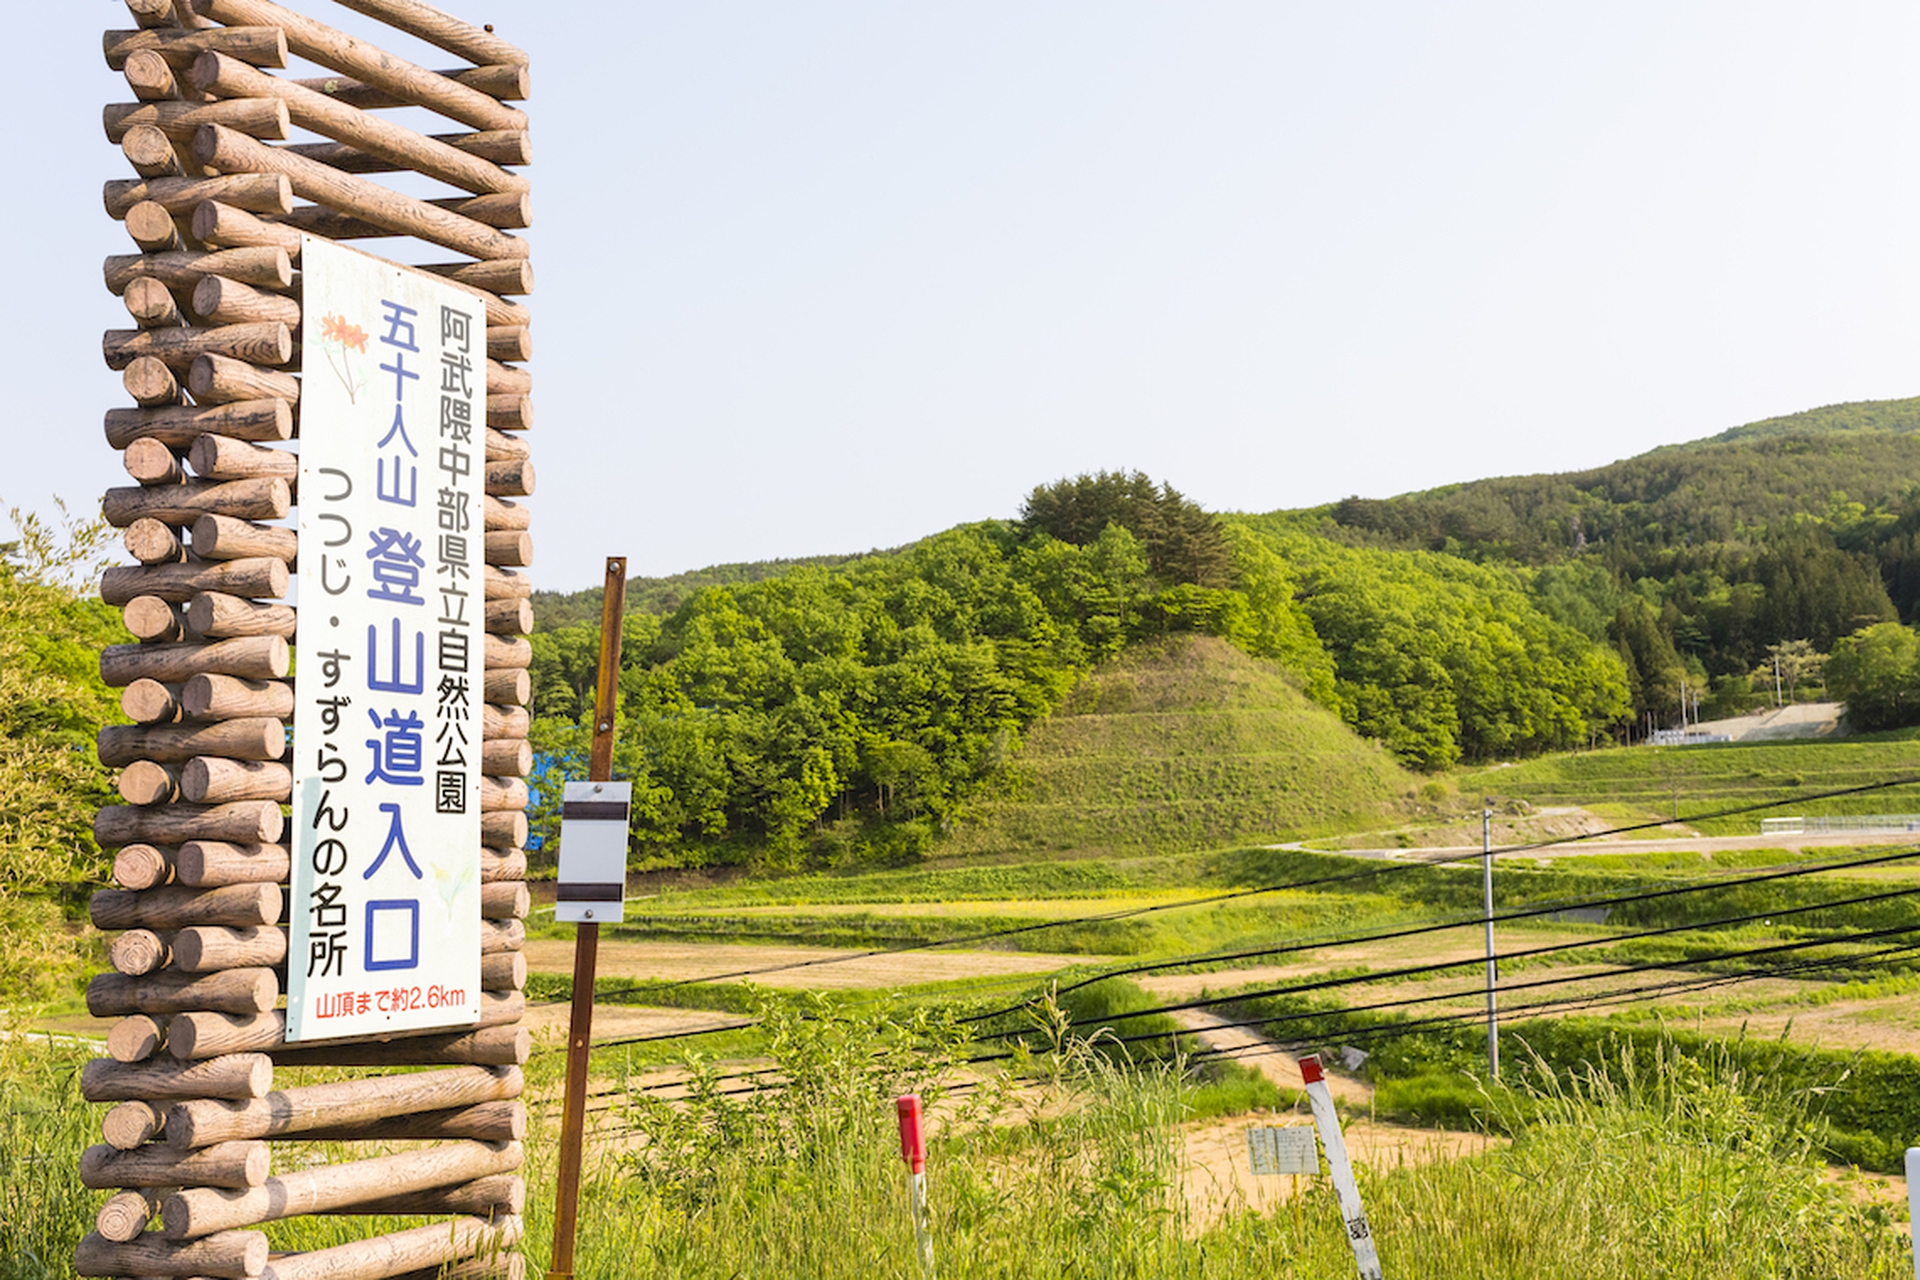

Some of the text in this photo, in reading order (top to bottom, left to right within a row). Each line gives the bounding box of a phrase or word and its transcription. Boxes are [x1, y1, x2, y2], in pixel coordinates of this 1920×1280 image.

[307, 467, 352, 978] つつじ・すずらんの名所
[435, 305, 473, 814] 阿武隈中部県立自然公園
[315, 984, 466, 1020] 山頂まで約2.6km
